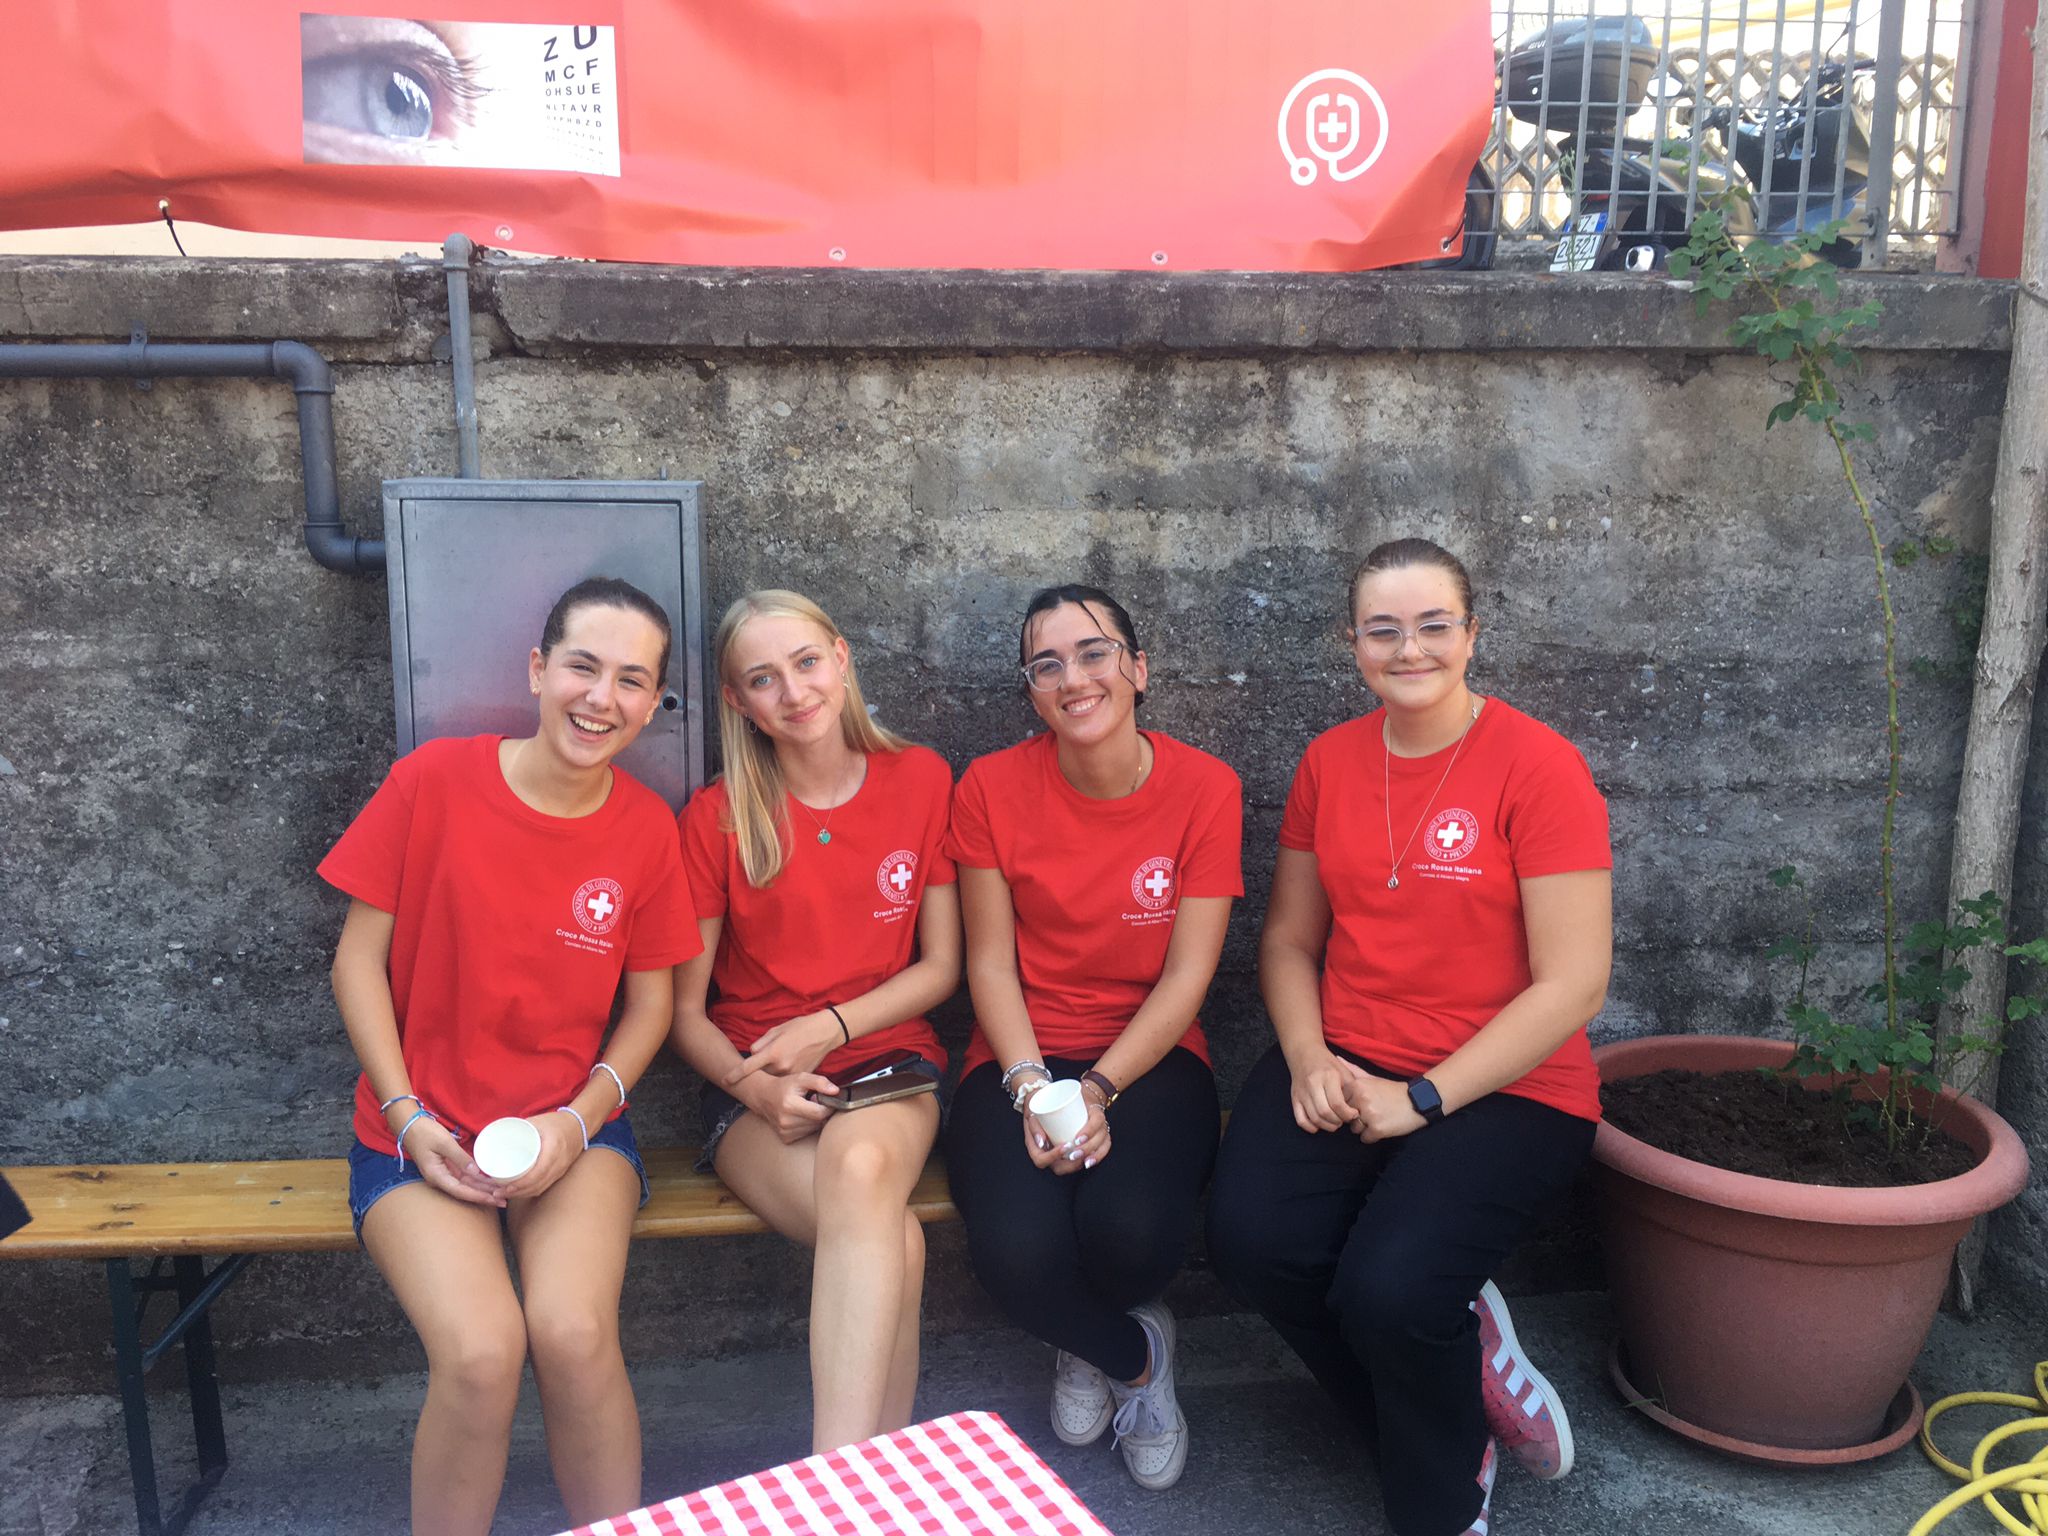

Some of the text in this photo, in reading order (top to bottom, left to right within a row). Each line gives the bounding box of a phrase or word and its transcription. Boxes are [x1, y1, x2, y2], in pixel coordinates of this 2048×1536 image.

[1430, 863, 1452, 873] Rossa
[1454, 865, 1482, 875] Italiana
[1121, 912, 1142, 920] Croce
[555, 928, 578, 940] Croce
